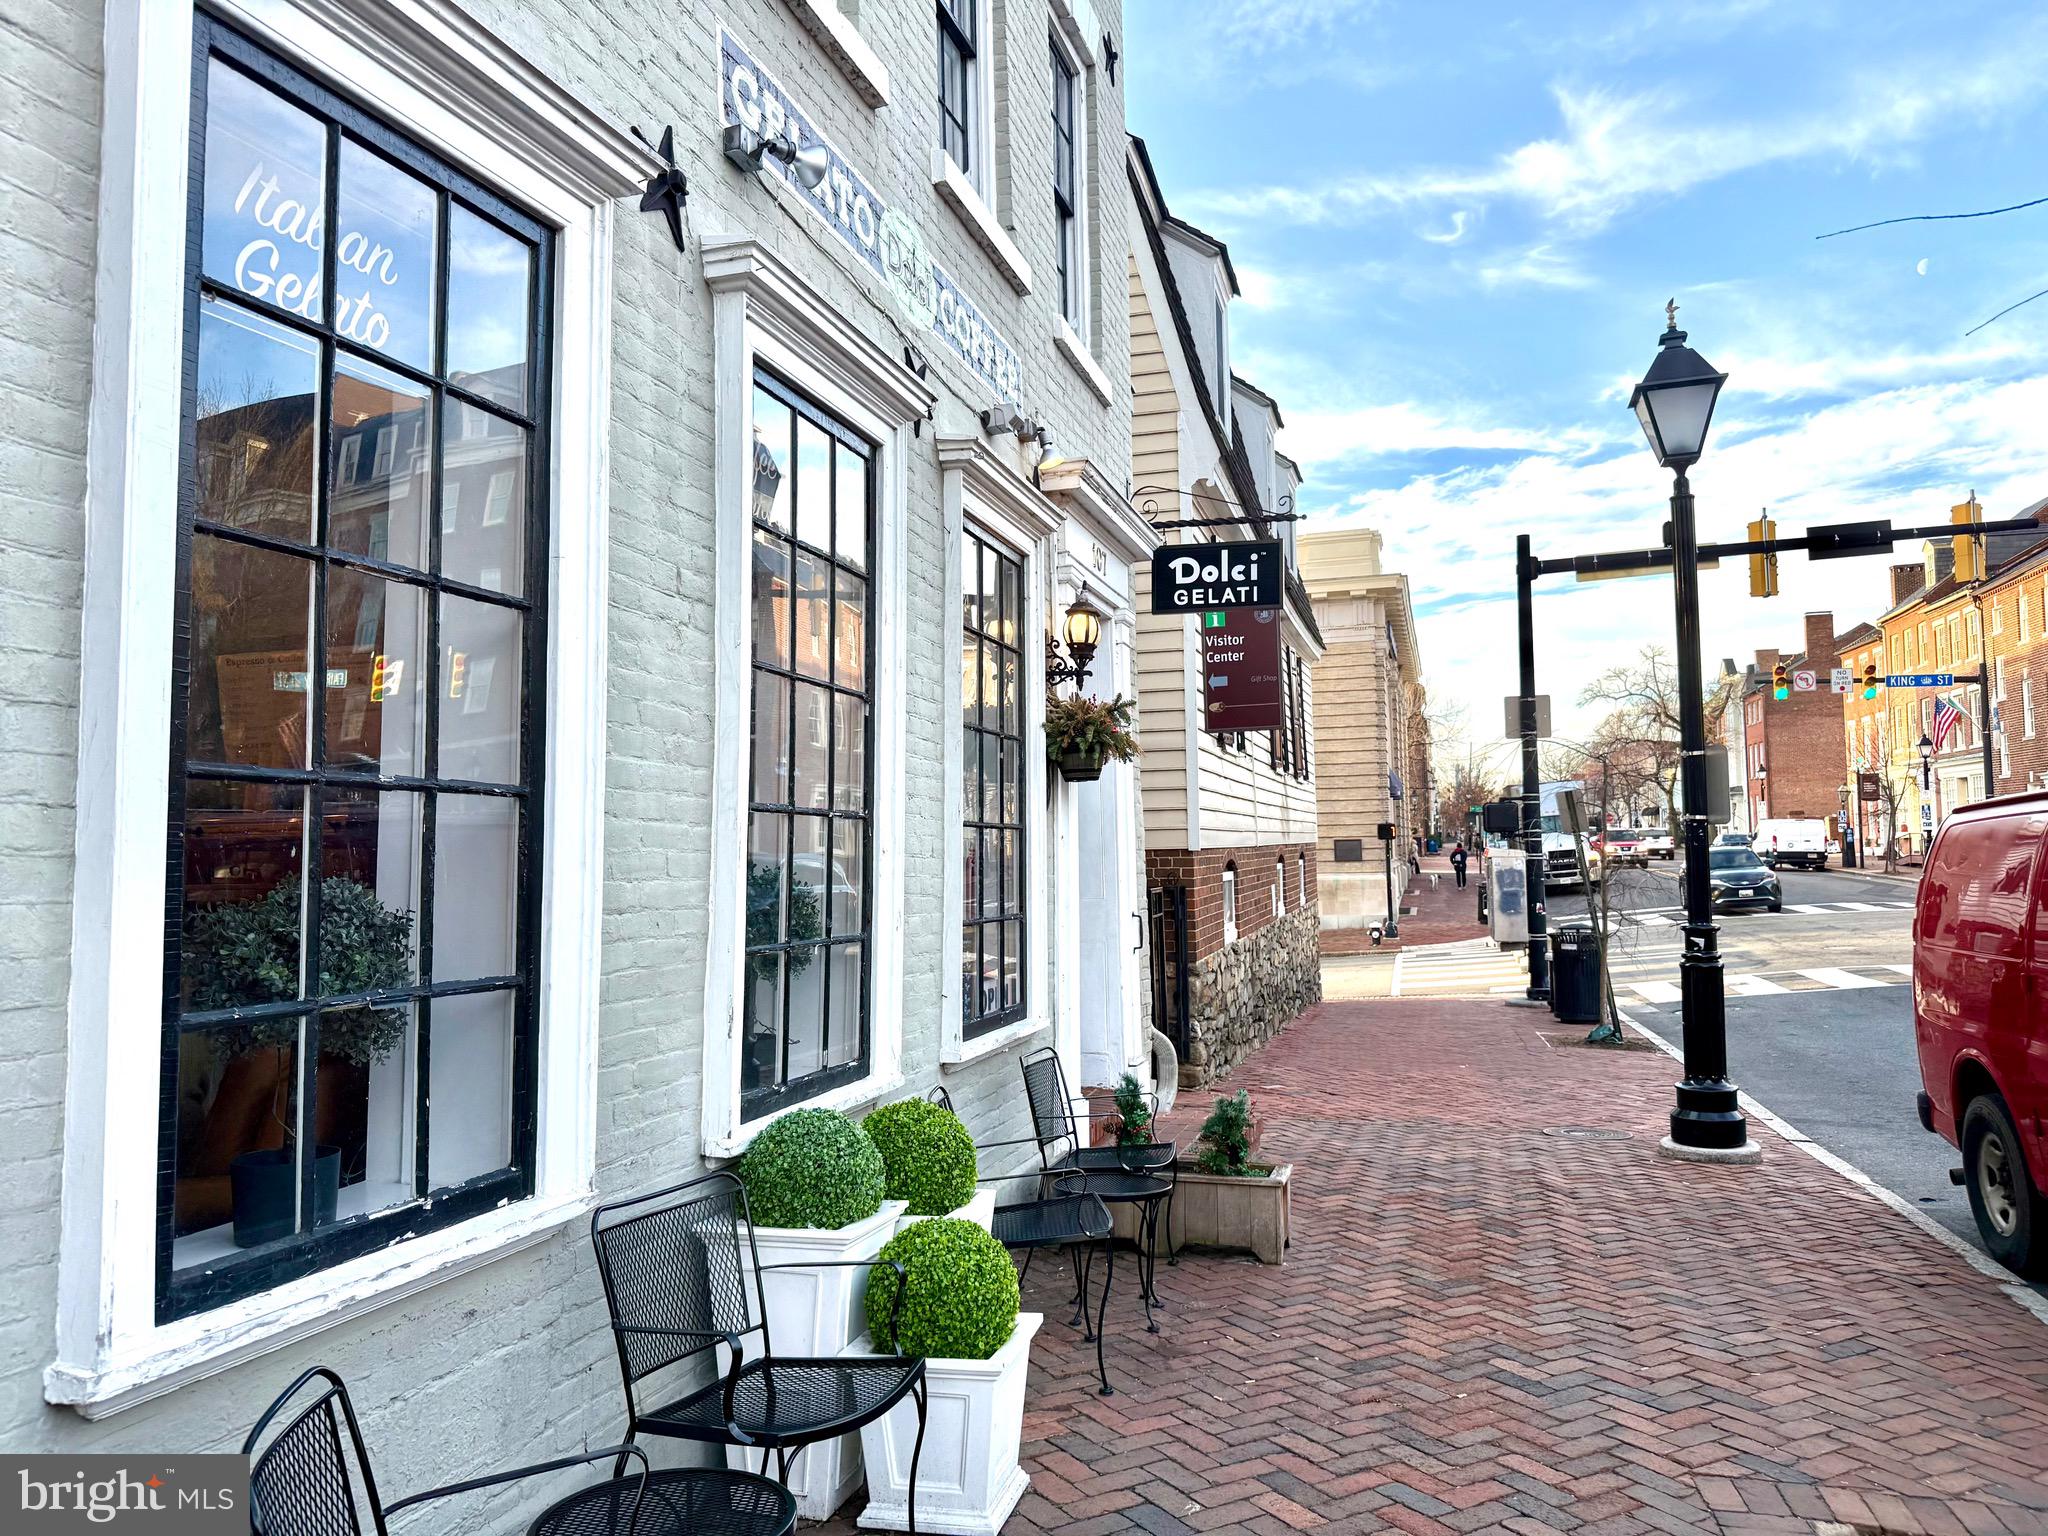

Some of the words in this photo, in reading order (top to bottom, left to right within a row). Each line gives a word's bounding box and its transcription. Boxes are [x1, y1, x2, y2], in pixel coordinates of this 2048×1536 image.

[940, 288, 1021, 402] COFFEE
[1168, 549, 1259, 585] Dolci
[1173, 585, 1258, 606] GELATI
[1205, 634, 1245, 647] Visitor
[1206, 651, 1245, 663] Center
[1250, 675, 1262, 683] Gift
[1263, 674, 1278, 683] Shop
[1890, 676, 1916, 687] KING
[1937, 675, 1950, 685] ST
